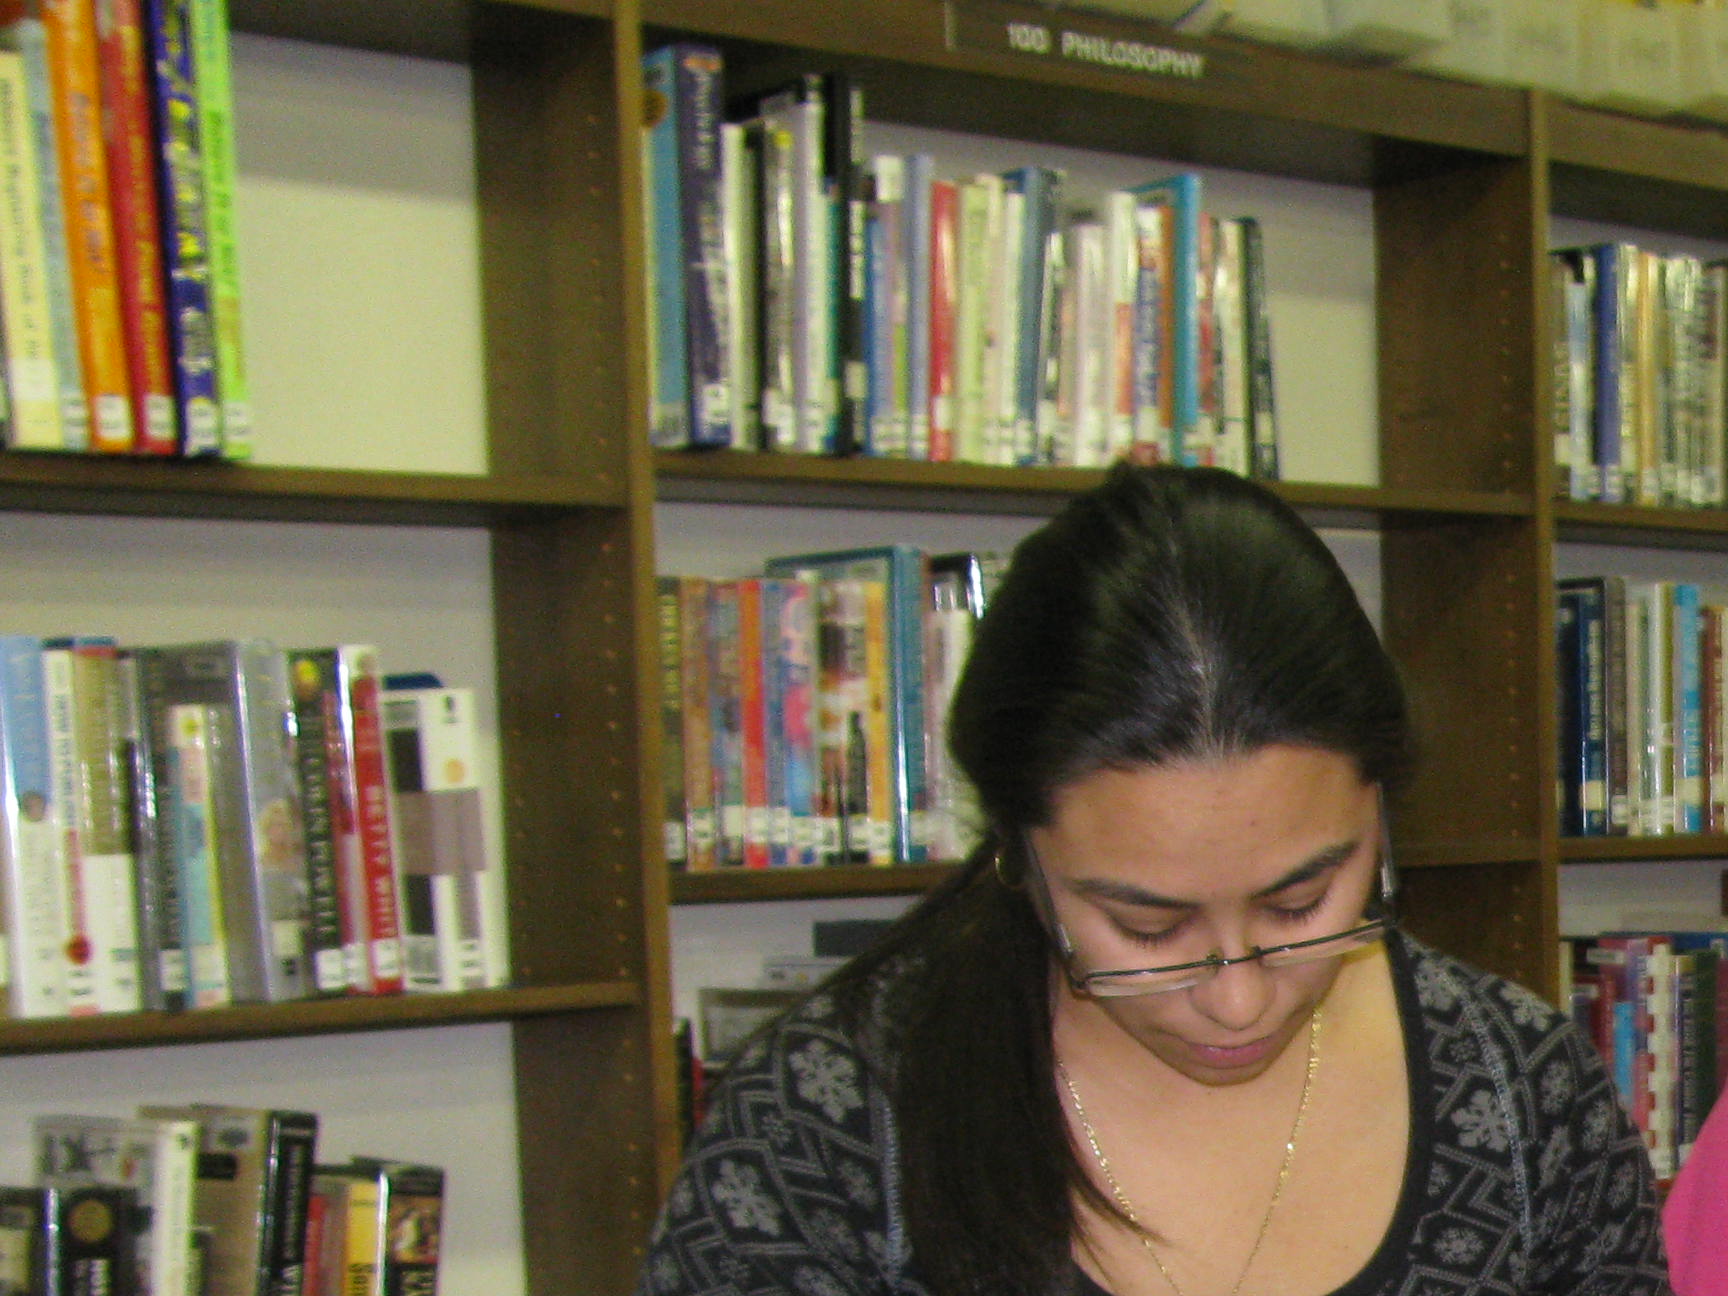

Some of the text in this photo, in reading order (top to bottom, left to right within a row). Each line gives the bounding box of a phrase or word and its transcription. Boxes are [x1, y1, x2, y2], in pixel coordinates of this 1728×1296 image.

[1007, 21, 1205, 79] 100 PHILOSOPHY
[364, 785, 395, 937] BETTY WHITE
